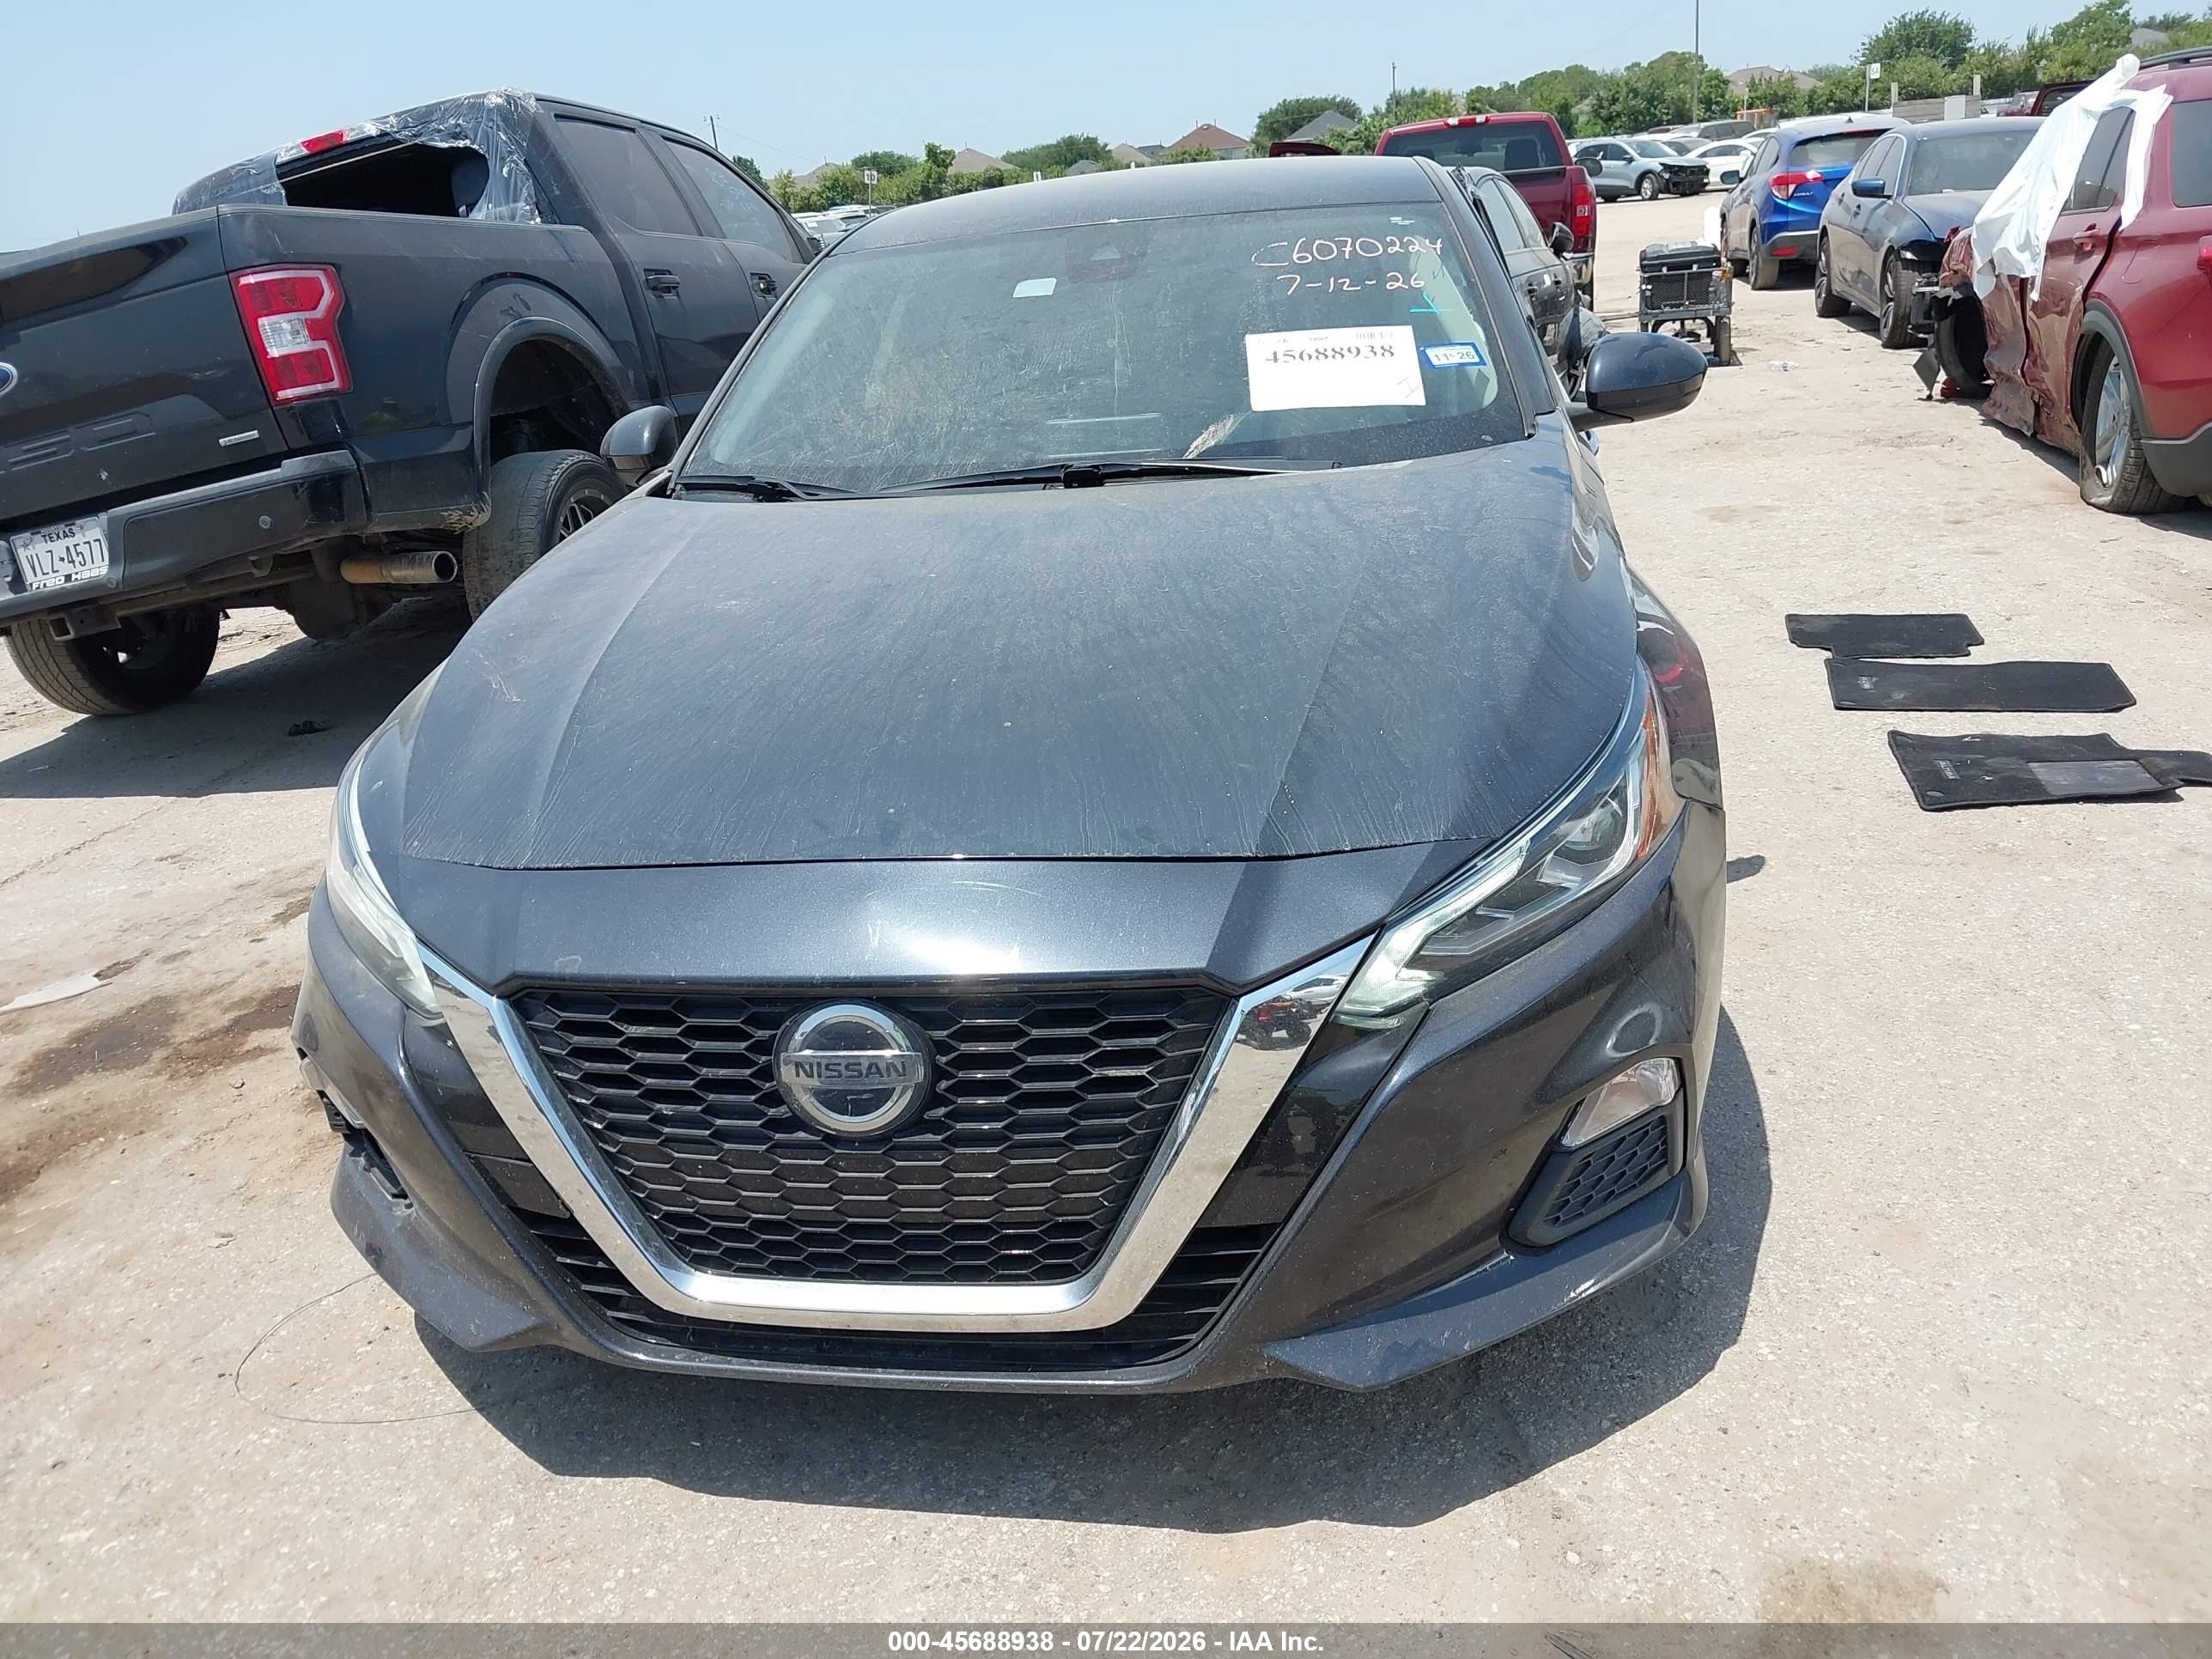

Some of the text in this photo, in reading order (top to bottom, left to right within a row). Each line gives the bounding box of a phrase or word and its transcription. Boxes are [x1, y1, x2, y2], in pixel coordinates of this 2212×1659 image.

[1250, 236, 1443, 266] C6070224
[1265, 343, 1395, 364] 45688938
[41, 527, 76, 544] TEXAS
[793, 1060, 908, 1079] NISSAN
